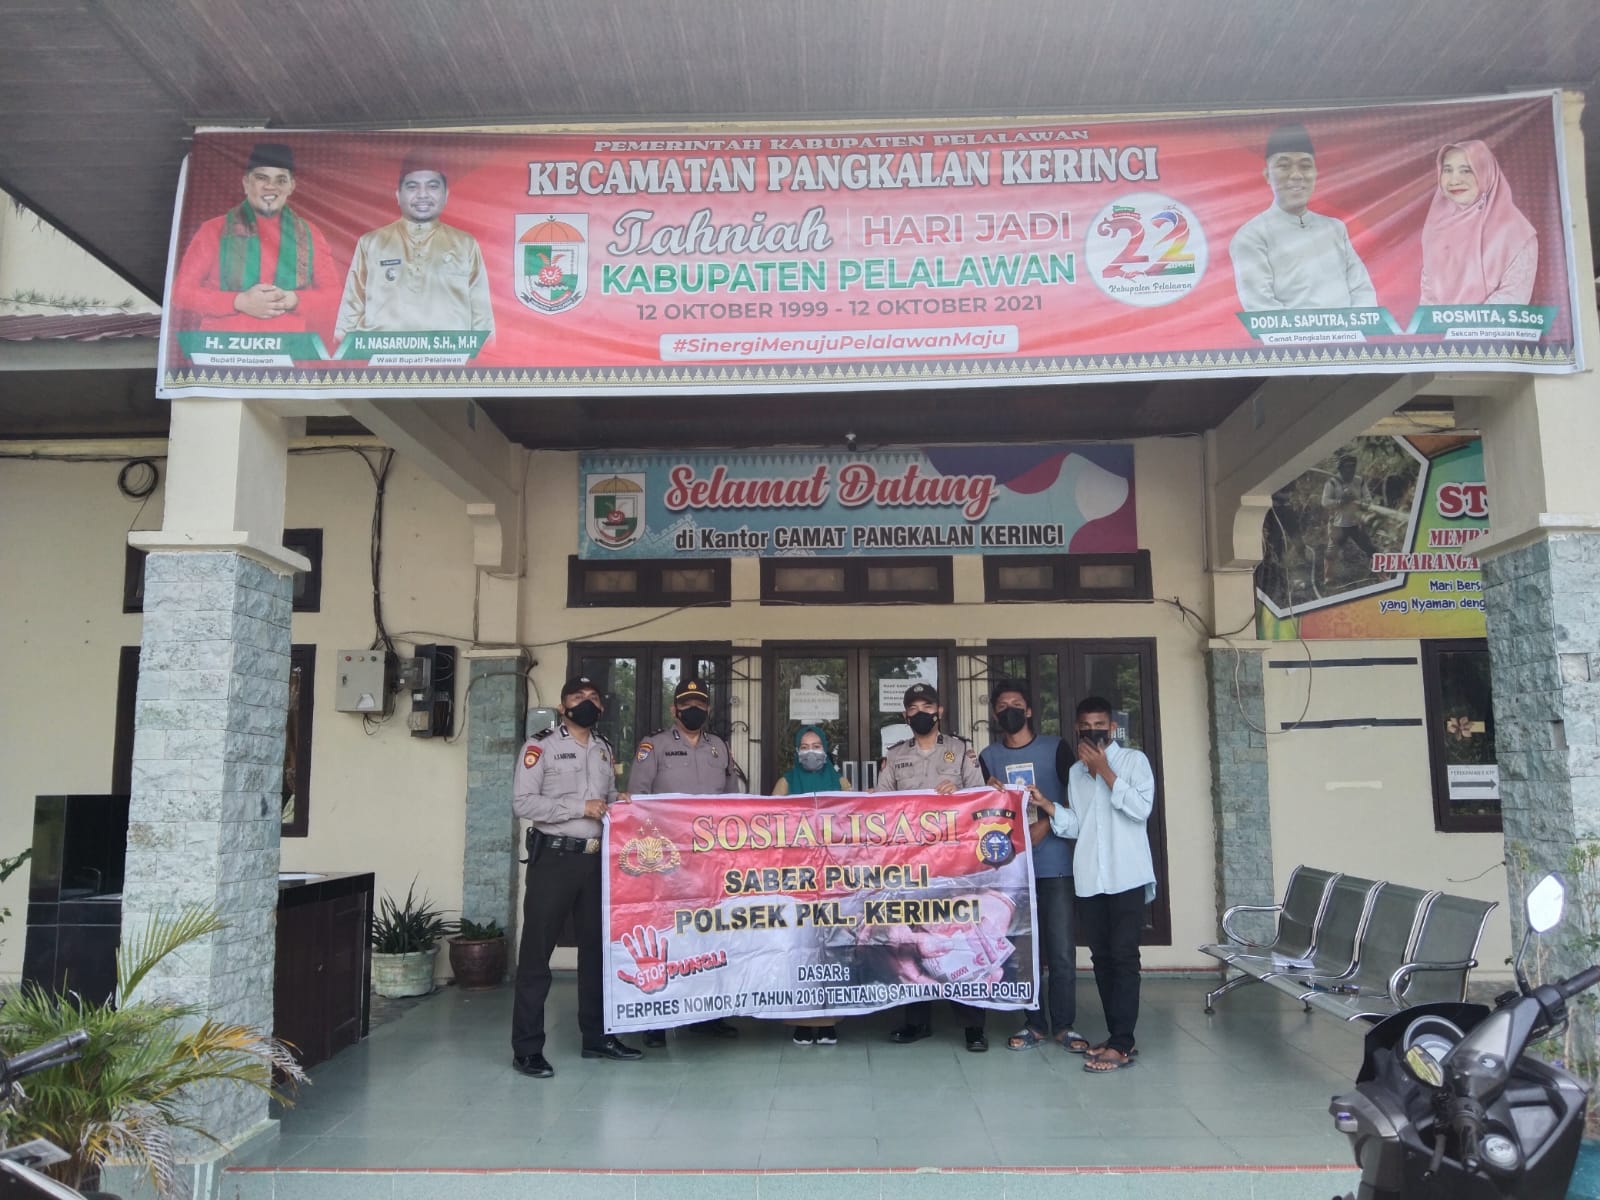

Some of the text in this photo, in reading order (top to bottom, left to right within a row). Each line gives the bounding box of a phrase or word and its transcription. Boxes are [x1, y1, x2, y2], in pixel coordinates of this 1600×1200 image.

[594, 129, 1089, 152] PEMERINTAH KABUPATEN PELALAWAN
[528, 145, 1158, 196] KECAMATAN PANGKALAN KERINCI
[607, 205, 833, 256] Tahniah
[863, 211, 1071, 246] HARI JADI
[601, 251, 1076, 294] KABUPATEN PELALAWAN
[636, 304, 658, 321] 12
[664, 302, 773, 320] OKTOBER
[779, 301, 829, 317] 1999
[848, 300, 870, 316] 12
[877, 297, 987, 315] OKTOBER
[994, 295, 1042, 312] 2021
[1432, 310, 1544, 325] ROSMITA, S.Sos
[1250, 313, 1380, 329] DODI A. SAPUTRA, S.STP
[205, 336, 281, 350] H. ZUKRI
[355, 336, 366, 349] H.
[367, 336, 431, 350] NASARUDIN,
[672, 330, 1006, 355] #SinergiMenujuPelalawanMaju
[210, 356, 235, 365] Bupati
[666, 463, 998, 518] Selamat Datang
[1439, 484, 1487, 514] ST
[676, 524, 1064, 549] di Kantor CAMAT PANGKALAN KERINCI
[1429, 580, 1482, 591] Mari Bers
[1380, 600, 1408, 614] yang
[1411, 599, 1456, 612] Nyaman
[976, 810, 1013, 818] RIAU
[692, 810, 960, 853] SOSIALISASI
[724, 863, 929, 894] SABER PUNGLI
[674, 899, 982, 935] POLSEK PKL. KERINCI
[636, 963, 666, 986] STOP
[617, 999, 680, 1020] PERPRES
[683, 996, 733, 1014] NOMOR
[751, 991, 794, 1008] TAHUN
[797, 989, 824, 1005] 2016
[826, 985, 887, 1004] TENTANG
[889, 982, 939, 1001] SATUAN
[944, 983, 988, 998] SABER
[991, 981, 1031, 998] POLRI
